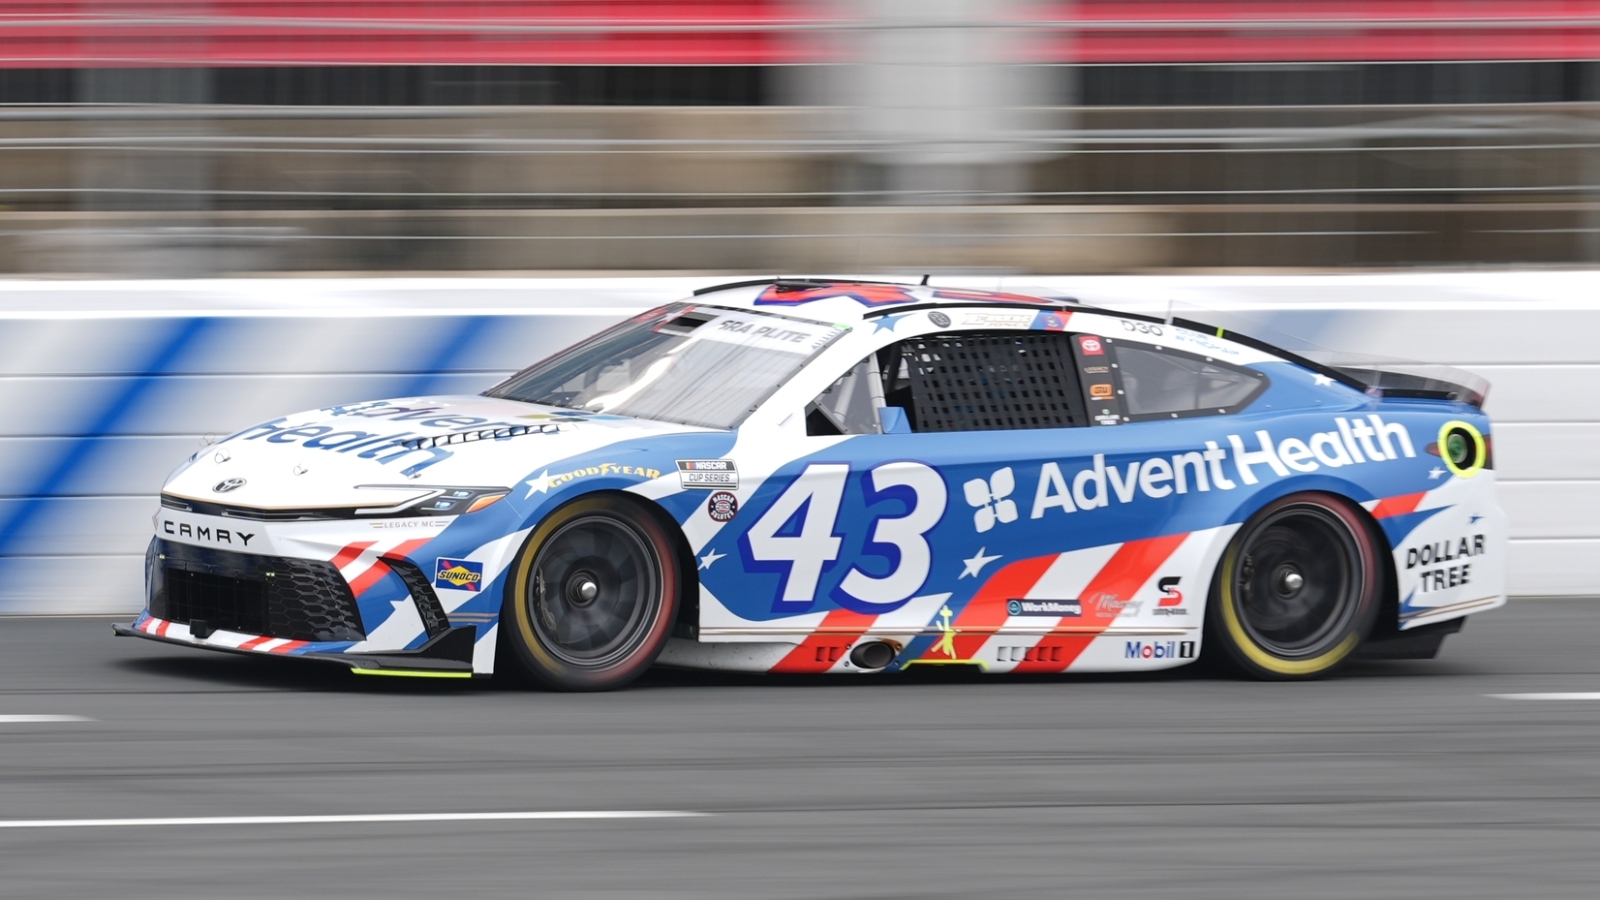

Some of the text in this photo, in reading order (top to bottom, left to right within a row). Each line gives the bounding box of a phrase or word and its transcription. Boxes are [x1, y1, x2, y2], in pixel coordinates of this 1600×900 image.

[751, 324, 812, 344] PLITE
[547, 463, 661, 488] GOODYEAR
[695, 461, 727, 470] NASCAR
[1030, 413, 1417, 521] AdventHealth
[689, 473, 730, 483] CUP SERIES
[164, 520, 256, 547] CAMRY
[384, 520, 435, 529] LEGACY MC
[738, 461, 947, 612] 43
[1406, 533, 1485, 569] DOLLAR
[438, 571, 481, 582] SUNOCO
[1420, 563, 1472, 593] TREE
[1021, 602, 1082, 615] WorkMoney
[1125, 641, 1192, 659] Mobil 1
